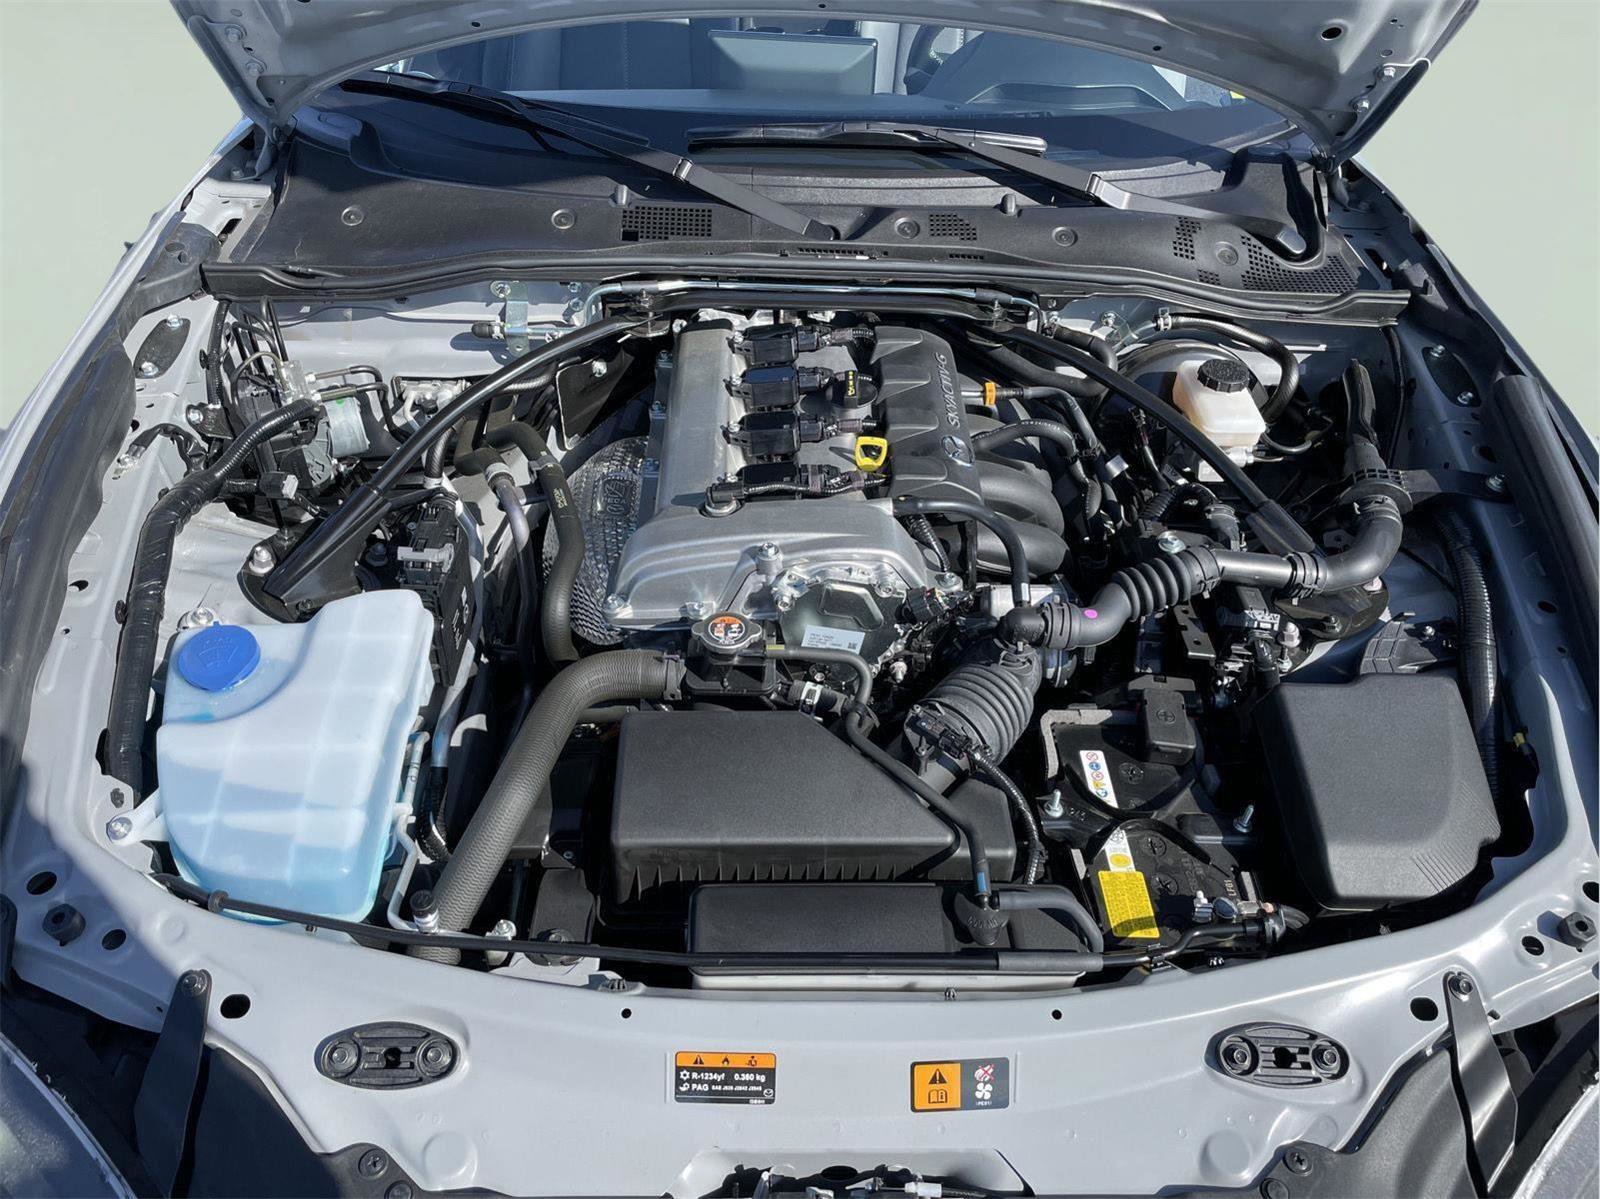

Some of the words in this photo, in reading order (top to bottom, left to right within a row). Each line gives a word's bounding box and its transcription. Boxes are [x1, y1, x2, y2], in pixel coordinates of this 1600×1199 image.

[935, 352, 960, 429] SKYACTIV-G
[691, 1072, 725, 1082] R-1234yf
[755, 1073, 766, 1083] kg
[691, 1084, 709, 1092] PAG
